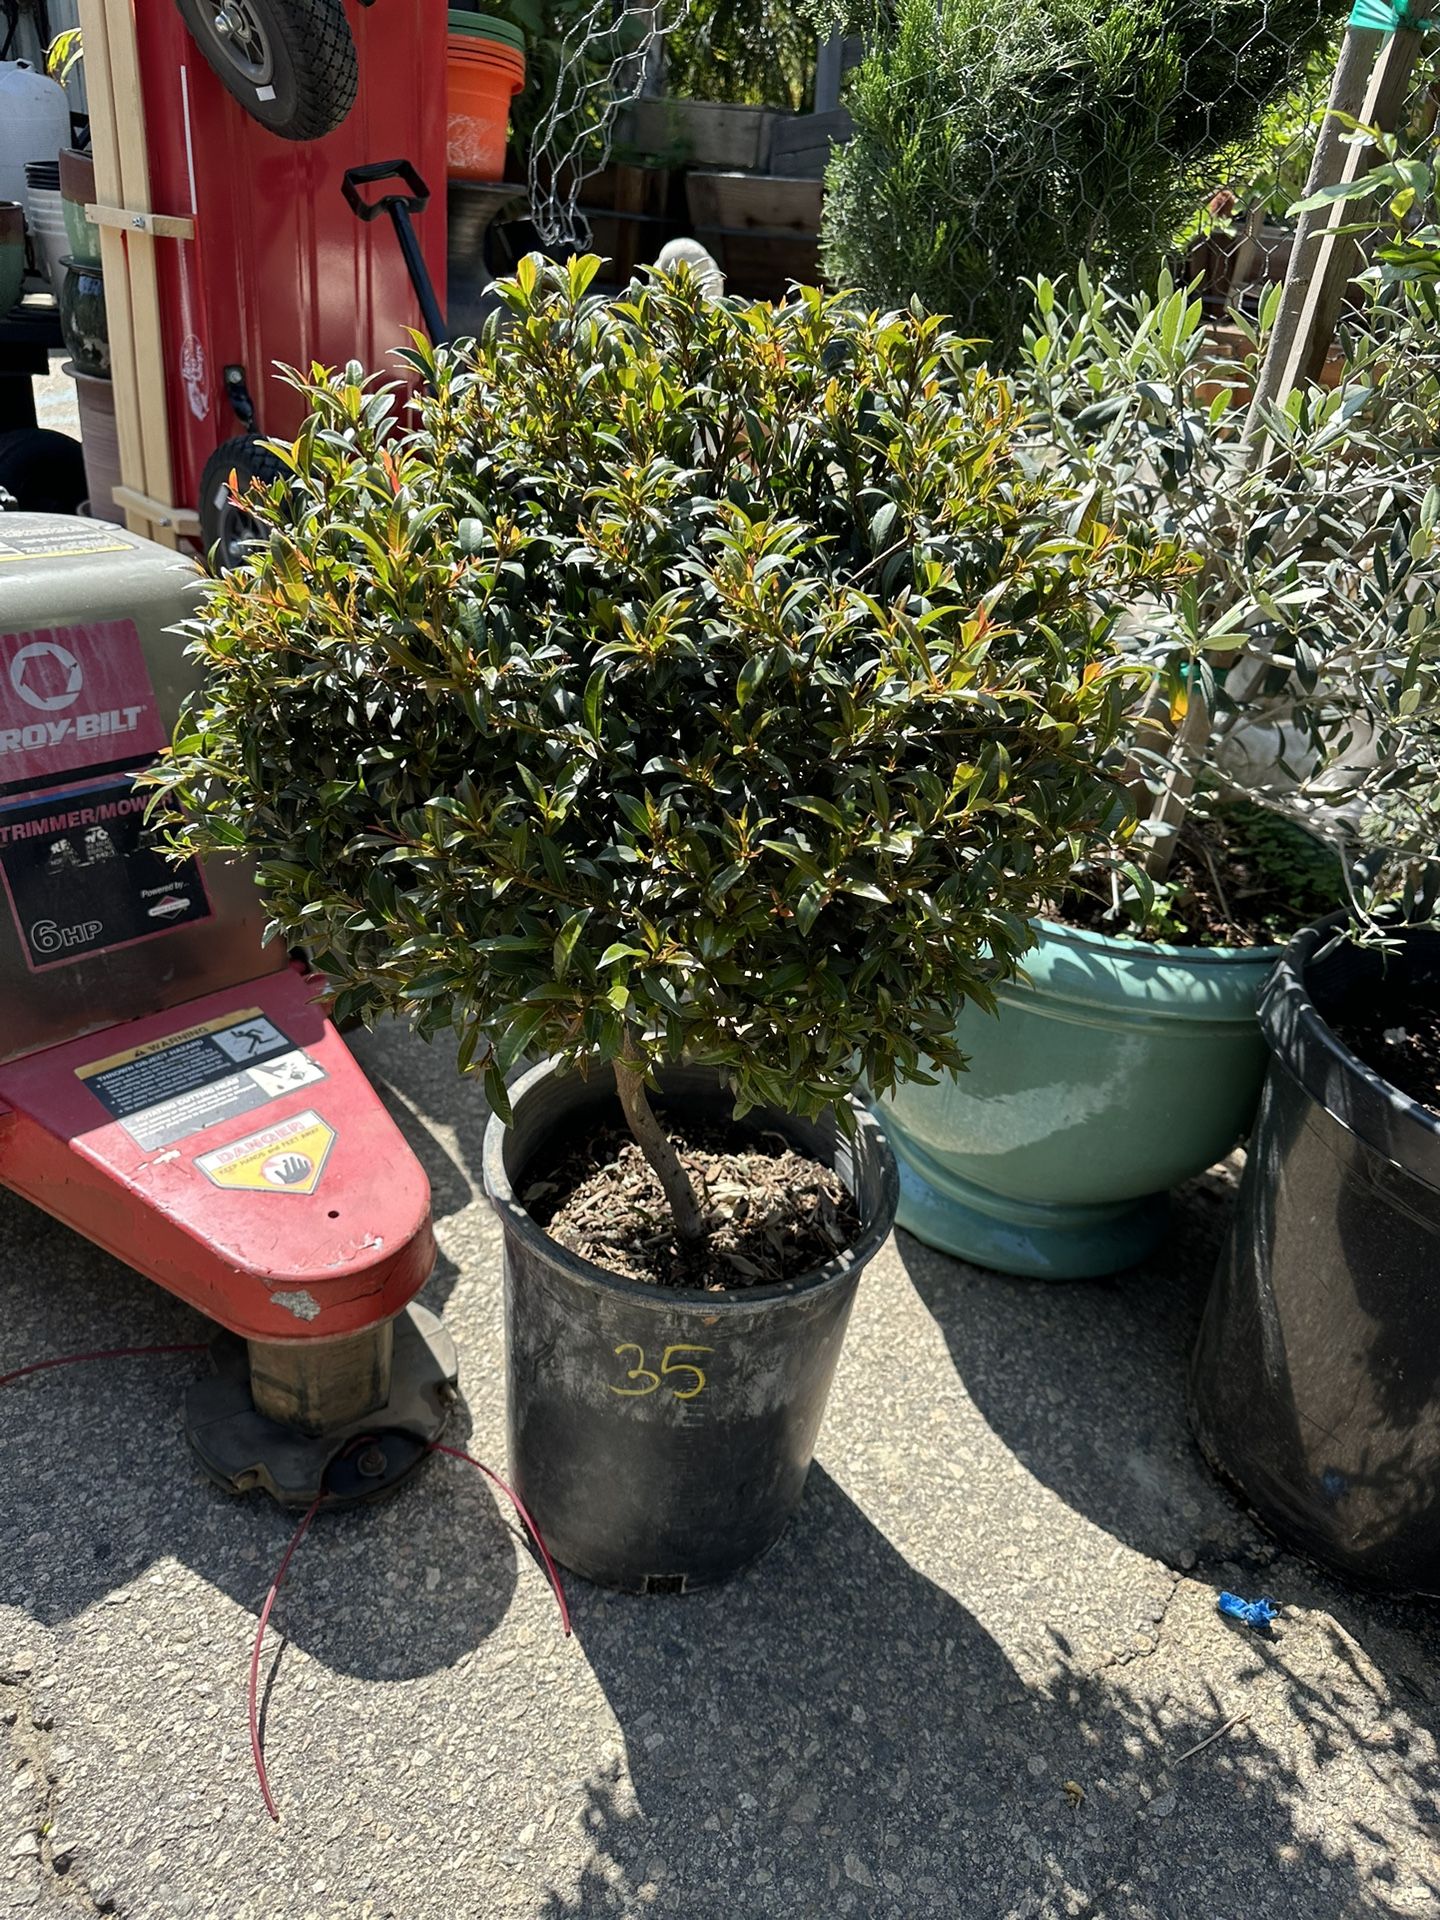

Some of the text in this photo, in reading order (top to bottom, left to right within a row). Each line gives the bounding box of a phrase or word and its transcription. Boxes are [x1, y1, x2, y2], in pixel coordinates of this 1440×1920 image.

[141, 883, 173, 899] Powered
[148, 1026, 209, 1051] WARNING
[96, 1039, 204, 1082] THROWN OBJECT HAZARD
[135, 1101, 177, 1123] ROTATING
[217, 1120, 305, 1163] DANGER
[239, 1151, 266, 1167] HANDS
[609, 1343, 715, 1400] 35
